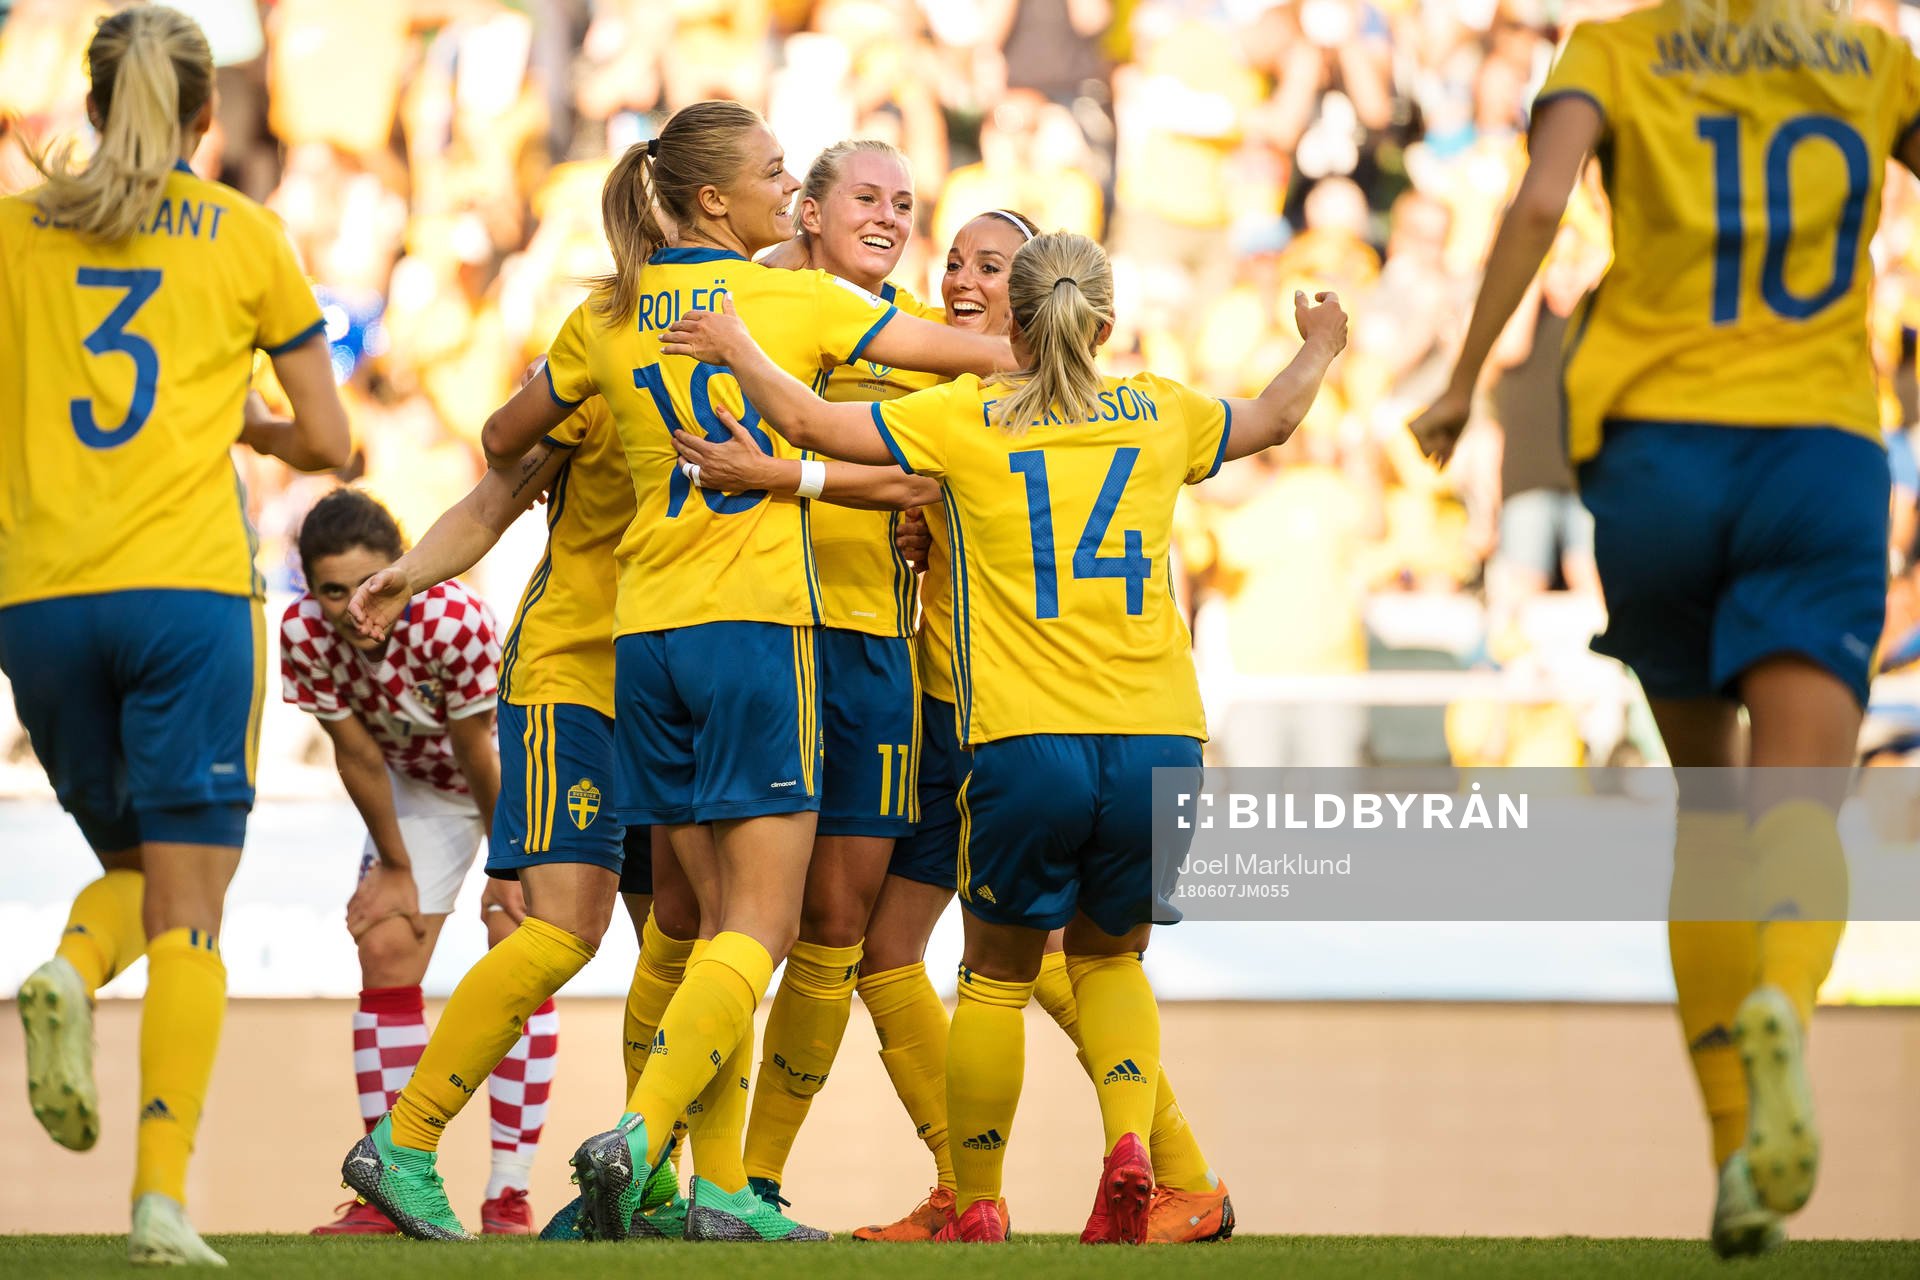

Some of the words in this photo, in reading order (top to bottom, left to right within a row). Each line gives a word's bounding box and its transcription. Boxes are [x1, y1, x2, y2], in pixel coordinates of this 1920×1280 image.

[1696, 113, 1872, 327] 10
[69, 266, 163, 451] 3
[632, 361, 774, 518] 18
[1008, 447, 1152, 619] 14
[878, 744, 909, 816] 11
[962, 1139, 1006, 1151] adidas
[1103, 1072, 1148, 1085] adidas
